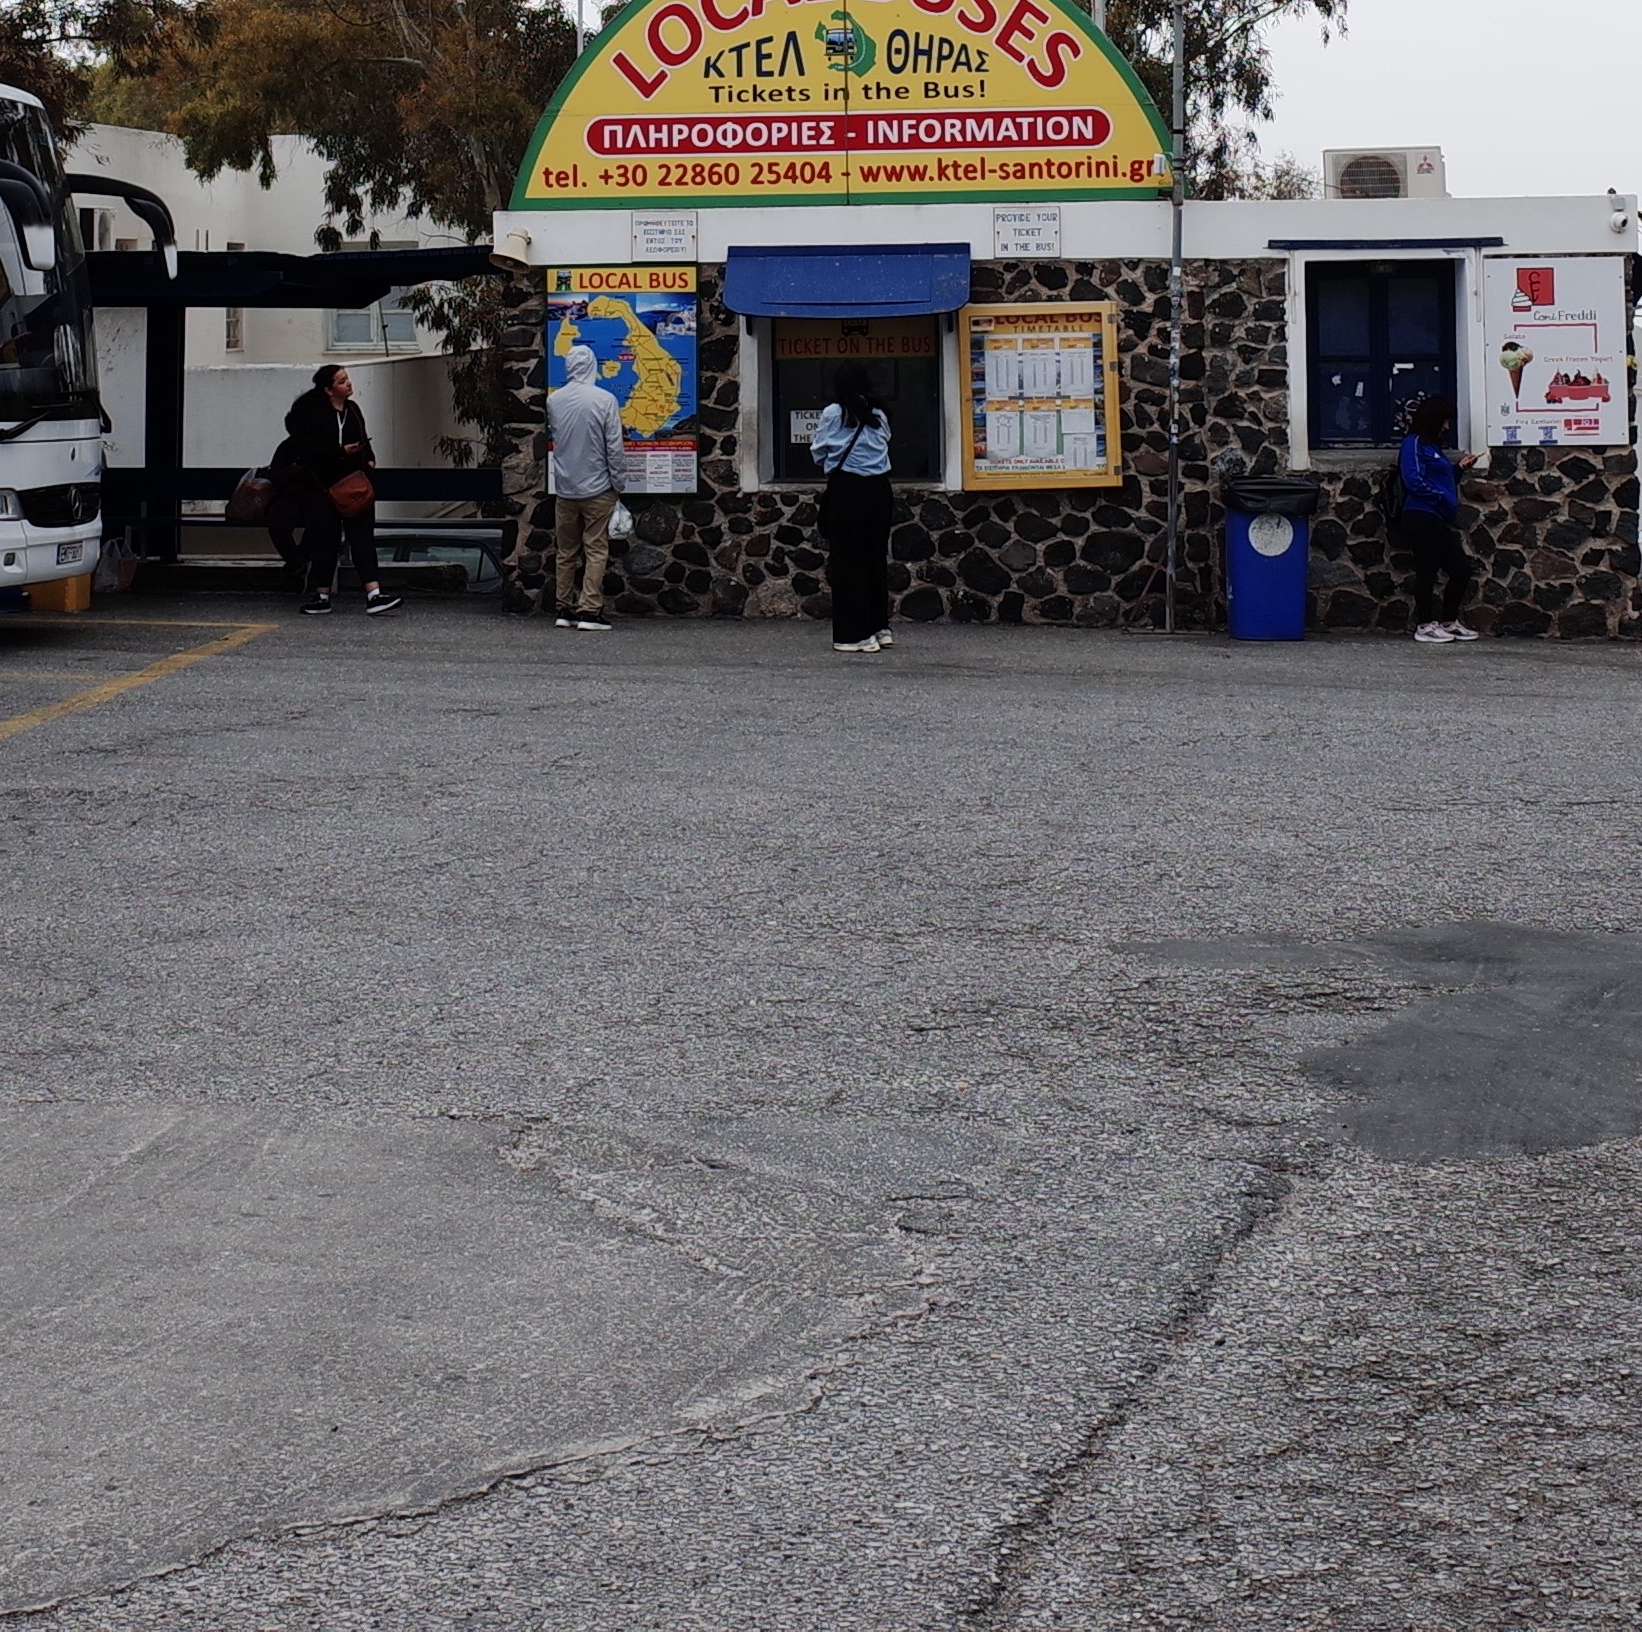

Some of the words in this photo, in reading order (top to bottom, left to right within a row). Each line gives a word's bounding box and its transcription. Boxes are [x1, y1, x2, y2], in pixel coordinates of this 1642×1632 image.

[703, 31, 806, 79] ΚΤΕΛ
[886, 29, 990, 75] ΘΗΡΑΣ
[708, 84, 811, 104] Tickets
[824, 84, 850, 101] in
[861, 82, 910, 100] the
[924, 80, 986, 99] Bus!
[603, 121, 835, 149] ΠΛΗΡΟΦΟΡΙΕΣ
[866, 115, 1094, 145] INFORMATION
[542, 164, 588, 188] tel.
[598, 164, 648, 188] +30
[657, 163, 740, 187] 22860
[750, 161, 833, 186] 25404
[996, 213, 1031, 222] PROVIDE
[1037, 213, 1058, 222] YOUR
[1013, 228, 1042, 237] TICKET
[1000, 243, 1009, 251] IN
[1014, 243, 1031, 251] THE
[1036, 243, 1055, 251] BUS!
[579, 272, 643, 289] LOCAL
[649, 272, 689, 289] BUS
[1558, 309, 1597, 321] Freddi
[1012, 324, 1084, 333] TIMETABLE
[778, 338, 832, 355] TICKET
[837, 337, 860, 354] ON
[866, 336, 895, 354] THE
[901, 336, 931, 353] BUS
[795, 411, 822, 420] TICKE
[794, 434, 812, 442] THE
